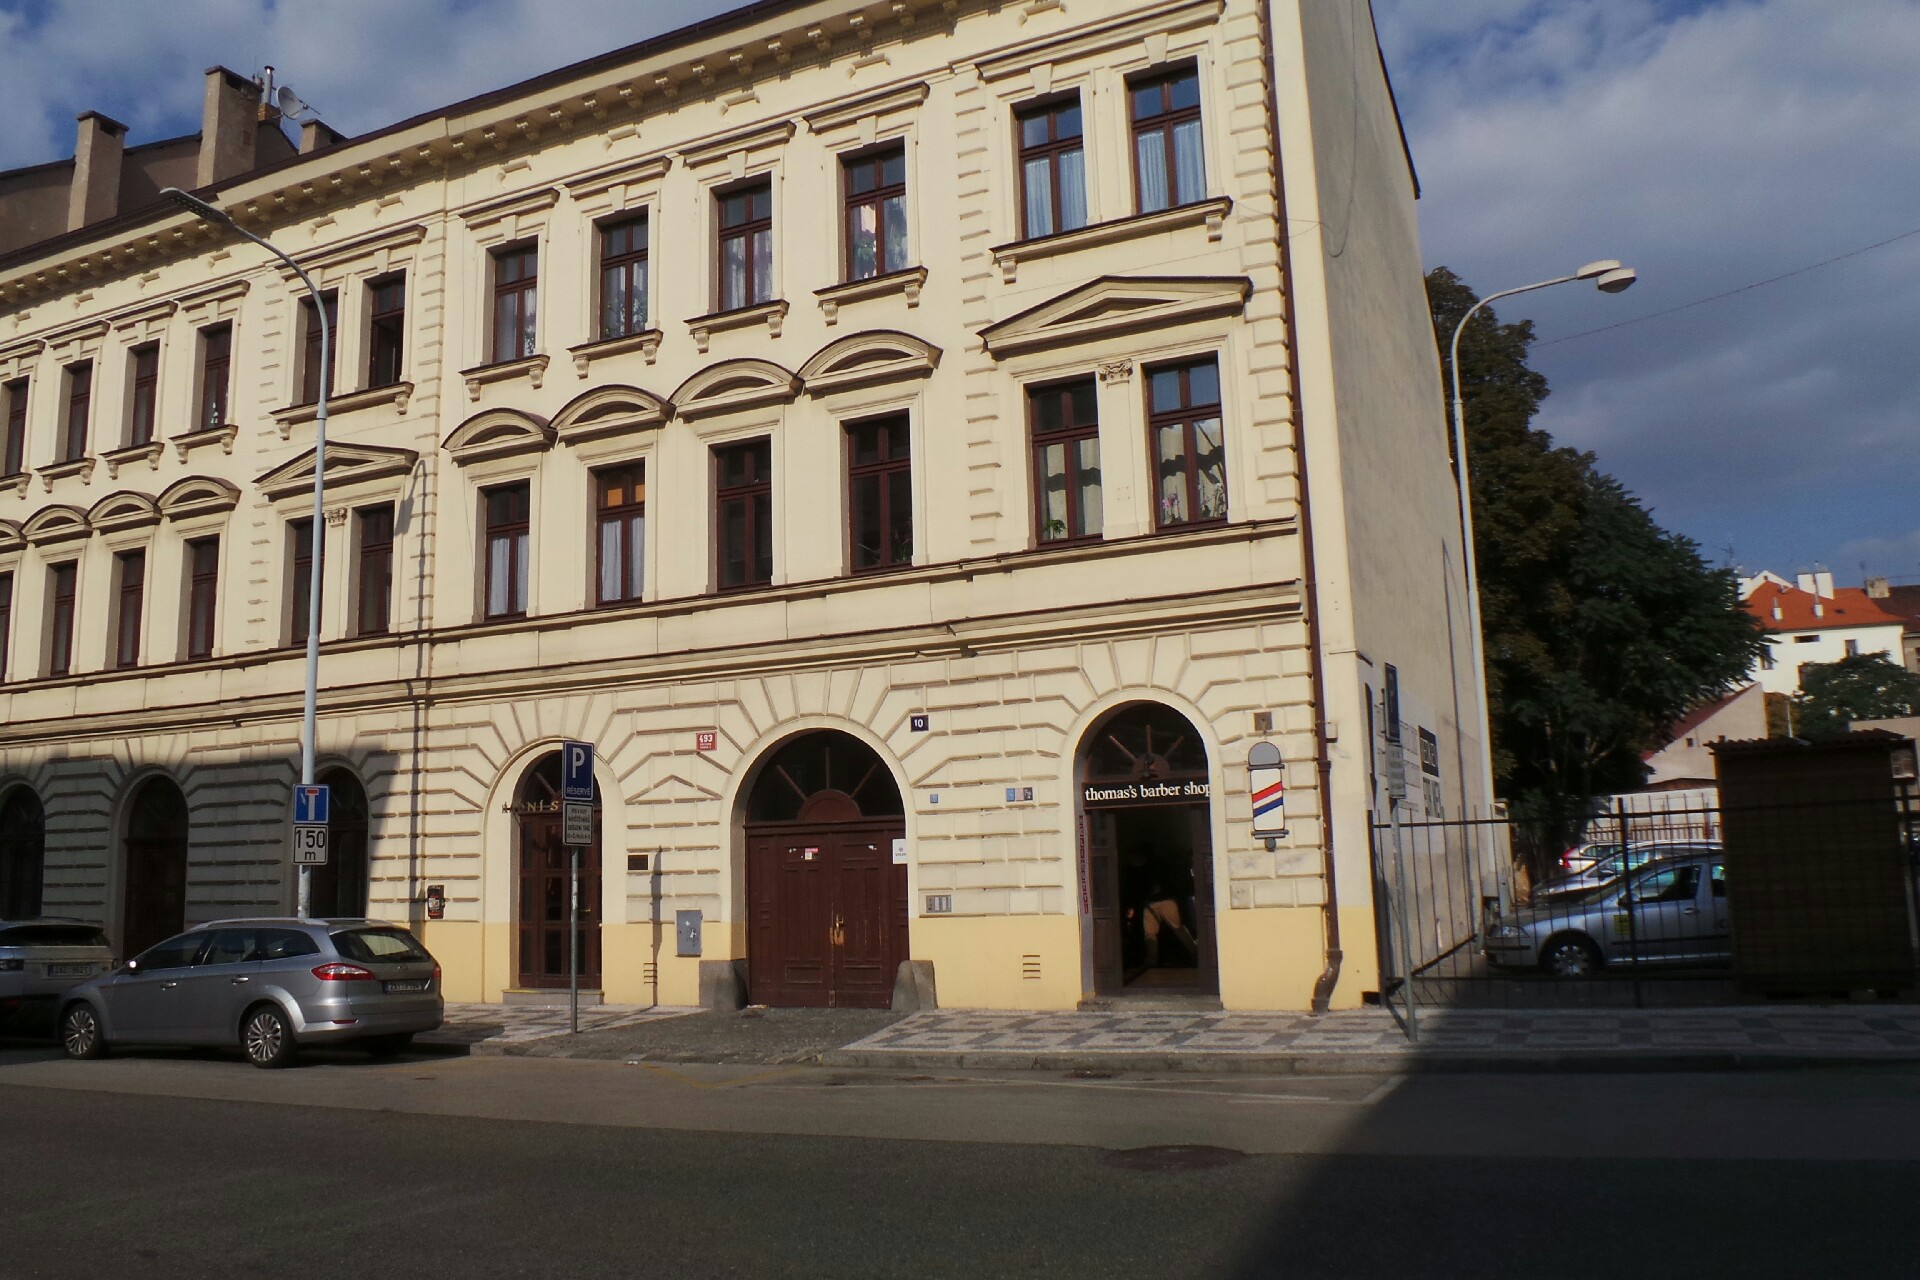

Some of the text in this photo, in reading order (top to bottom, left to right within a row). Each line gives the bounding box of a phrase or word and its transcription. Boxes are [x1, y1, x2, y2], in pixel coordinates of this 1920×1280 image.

[914, 718, 924, 728] 10
[699, 734, 713, 743] 493
[572, 747, 585, 778] P
[1085, 784, 1138, 801] thomas's
[1140, 783, 1181, 798] barber
[296, 829, 325, 848] 150
[304, 851, 316, 861] m
